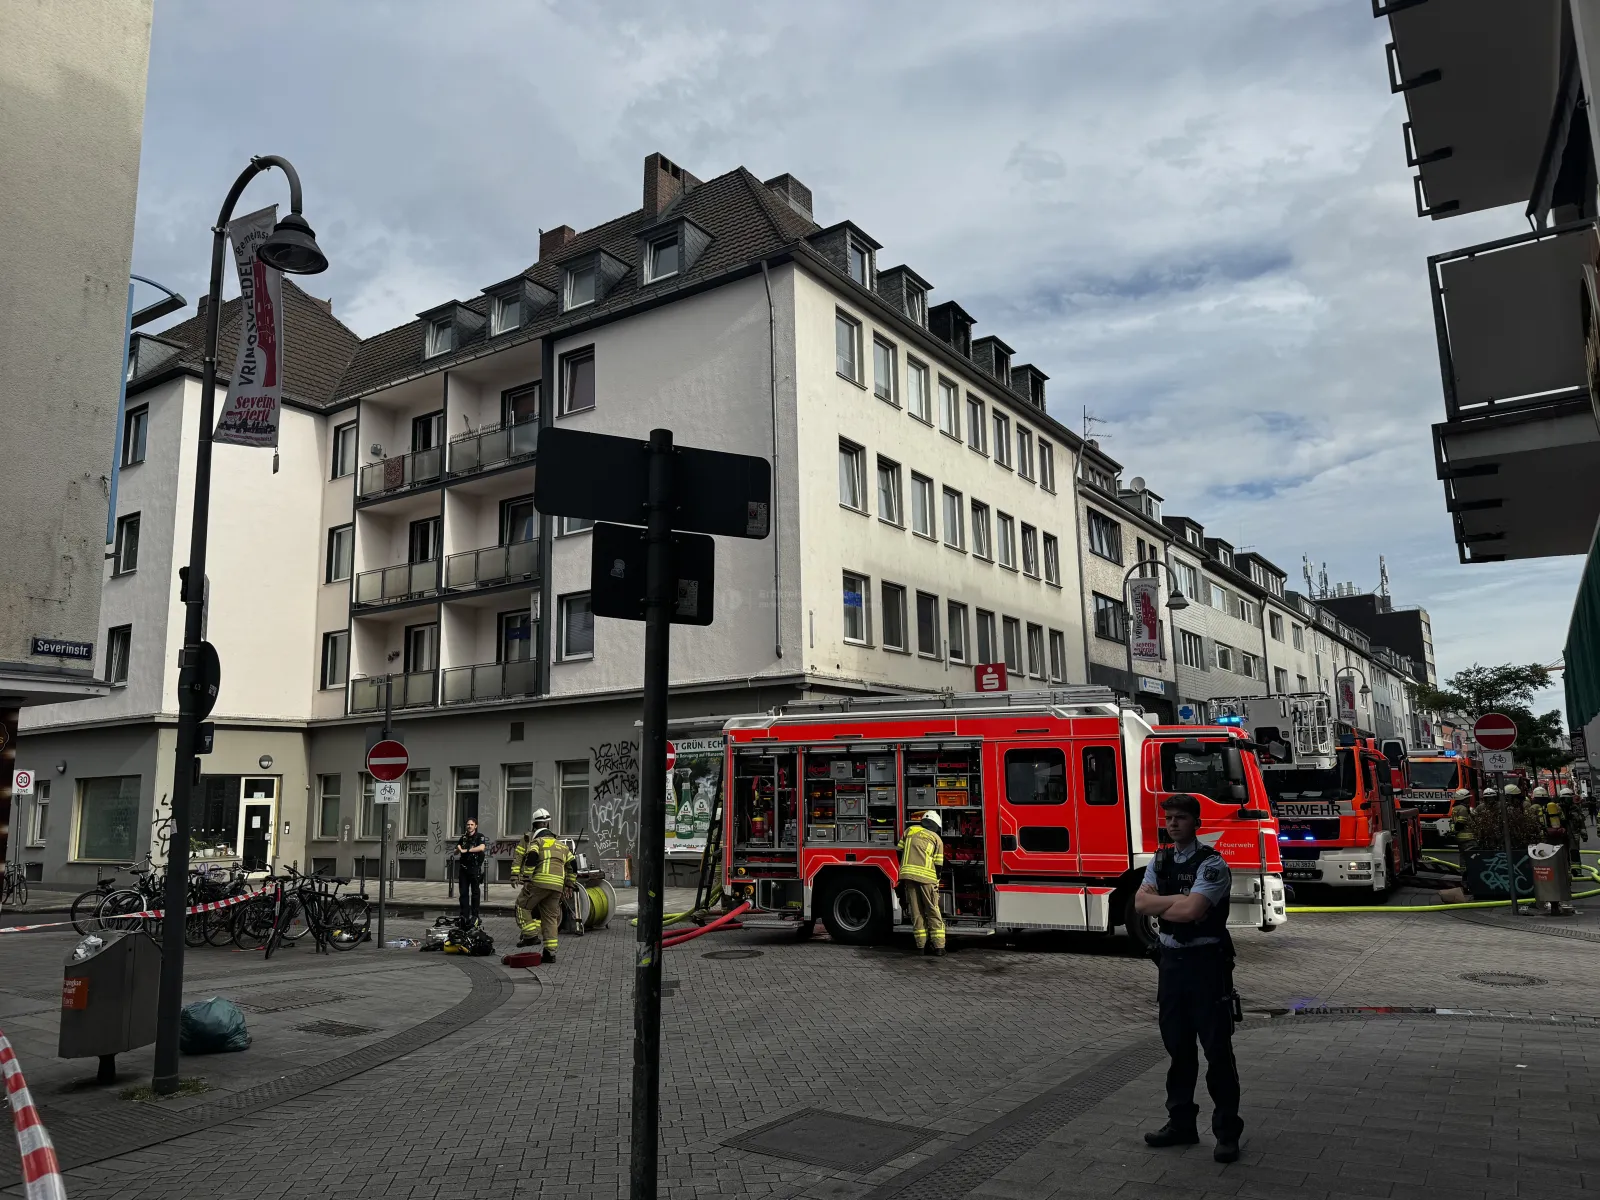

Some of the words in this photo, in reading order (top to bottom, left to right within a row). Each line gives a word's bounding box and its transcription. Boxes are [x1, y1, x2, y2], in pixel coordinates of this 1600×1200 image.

[37, 640, 89, 656] Severinstr.
[681, 739, 706, 750] GRÜN.
[708, 739, 724, 749] ECH
[19, 776, 28, 784] 30
[1277, 804, 1342, 816] ERWEHR
[1219, 841, 1255, 849] Feuerwehr
[1177, 873, 1194, 882] POLIZEI
